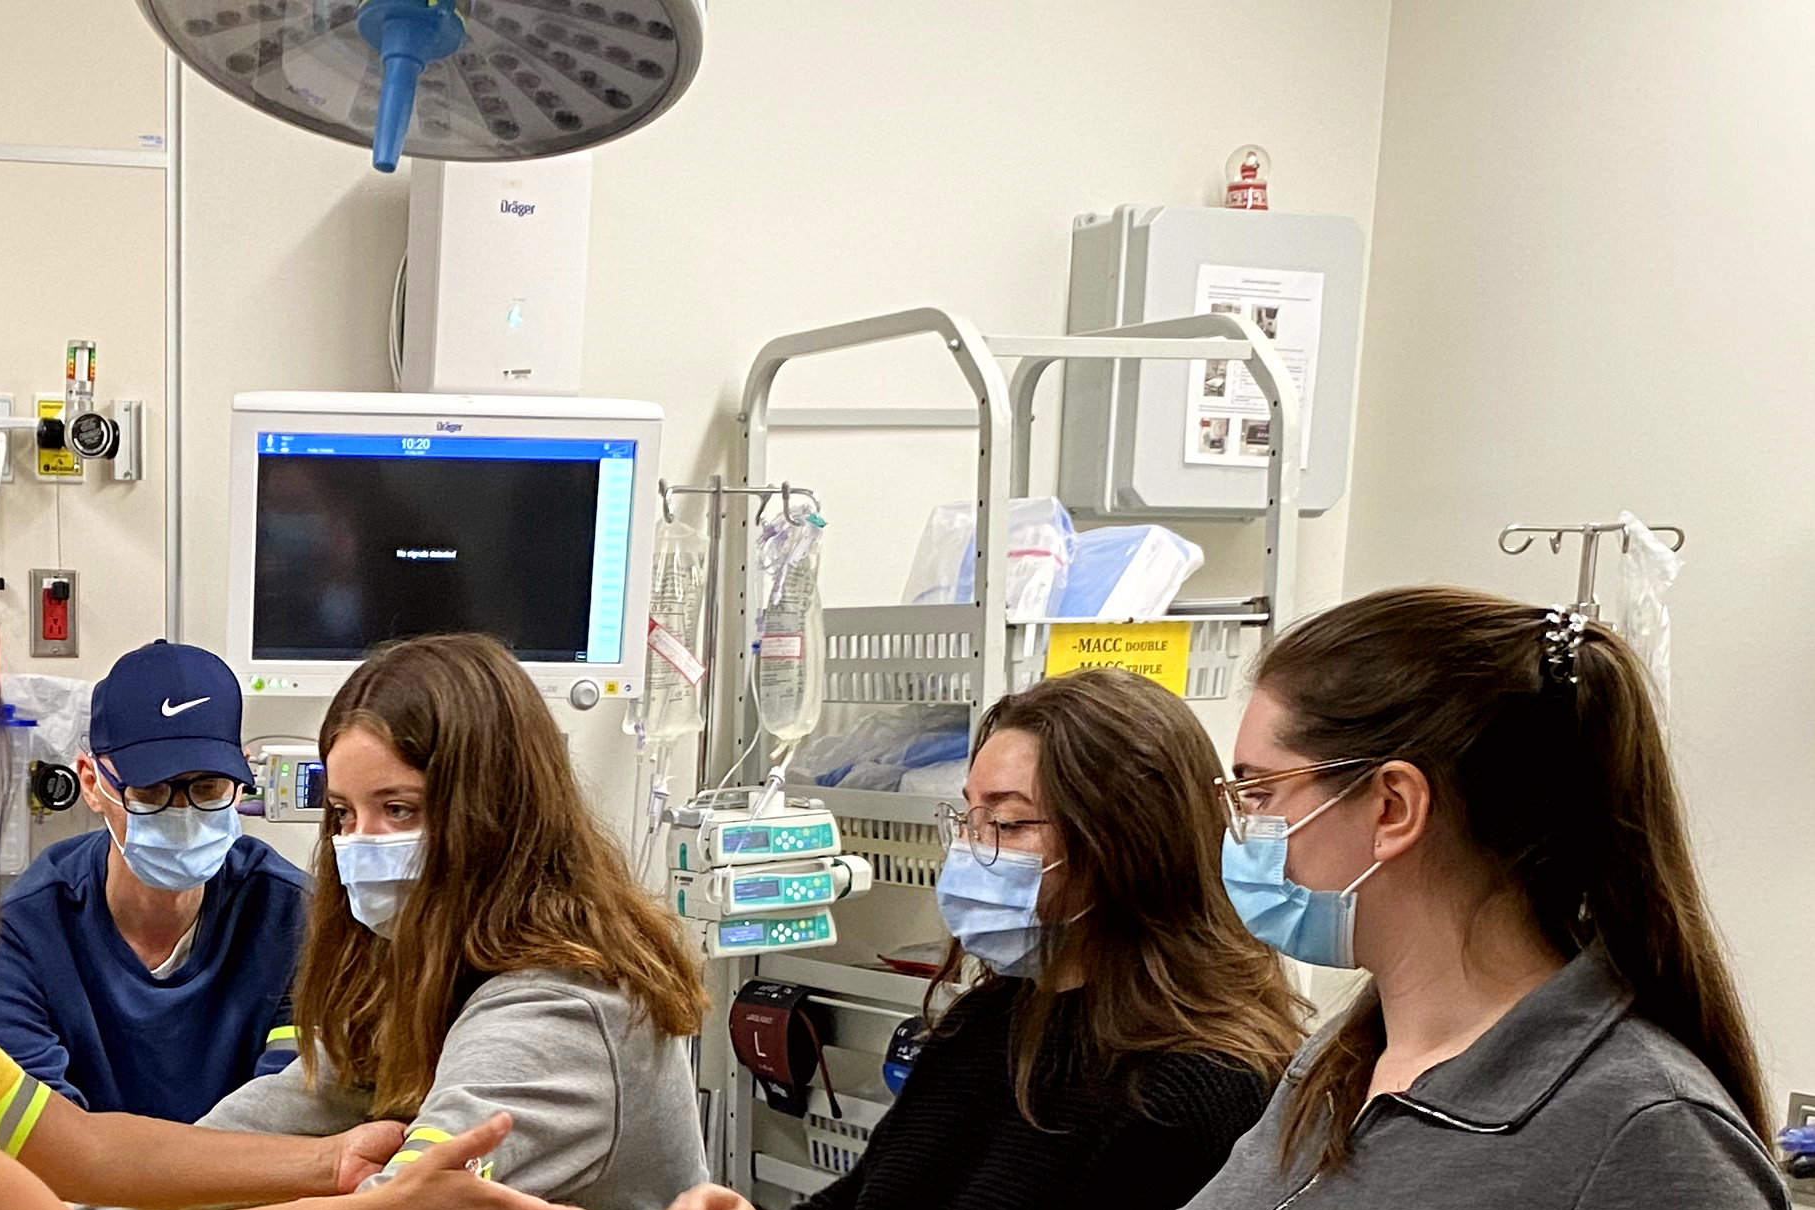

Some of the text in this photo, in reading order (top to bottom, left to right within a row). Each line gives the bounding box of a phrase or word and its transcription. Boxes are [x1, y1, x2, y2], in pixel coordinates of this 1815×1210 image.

[500, 199, 536, 217] Dräger
[401, 437, 431, 450] 10:20
[1072, 637, 1168, 653] -MACC DOUBLE
[1125, 664, 1162, 674] TRIPLE
[754, 1031, 767, 1057] L
